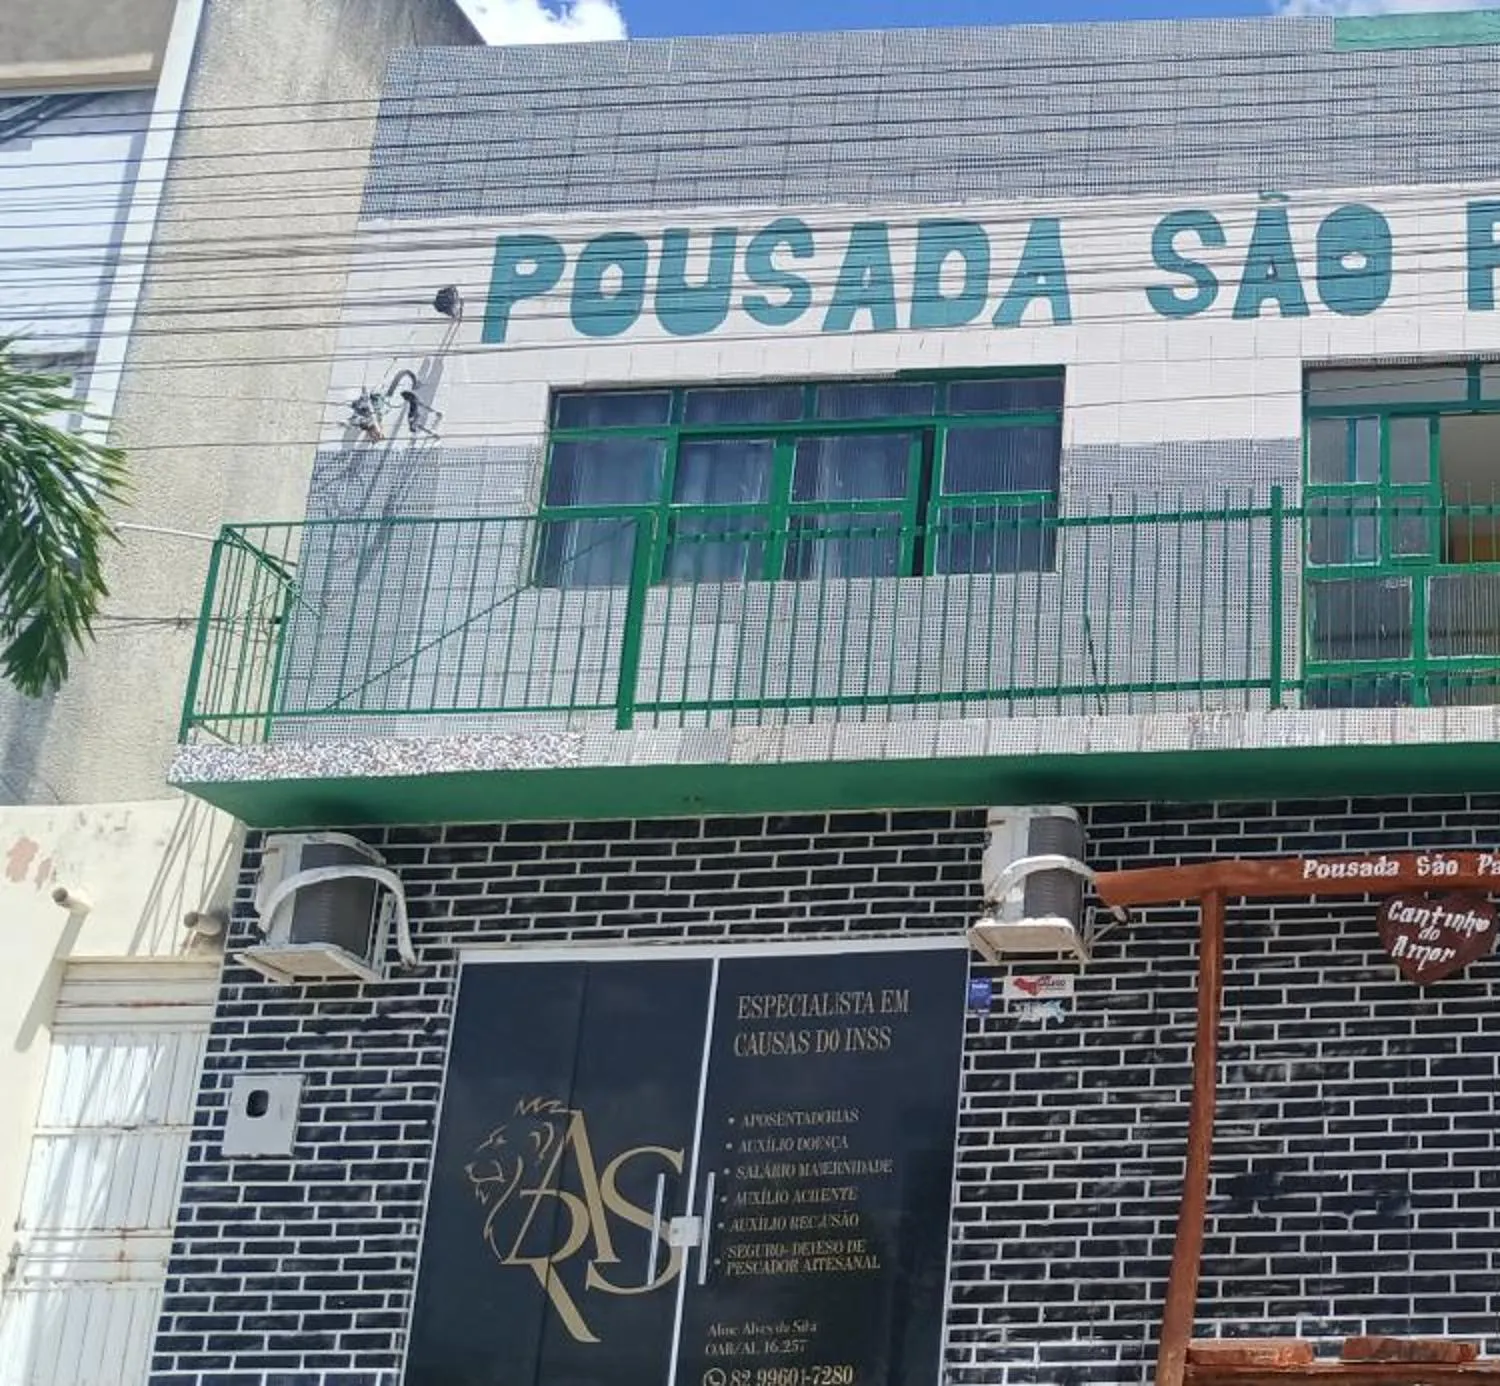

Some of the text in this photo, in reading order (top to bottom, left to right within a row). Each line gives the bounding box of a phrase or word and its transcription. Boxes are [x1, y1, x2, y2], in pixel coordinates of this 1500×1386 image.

[481, 217, 1072, 344] POUSADA
[1145, 191, 1392, 320] SÃO
[1303, 857, 1399, 878] Pousada
[1417, 854, 1458, 876] São
[1418, 926, 1440, 941] do
[1391, 935, 1456, 970] Amor
[737, 989, 910, 1019] ESPECIALISTA EM
[733, 1026, 892, 1056] CAUSAS DO INSS
